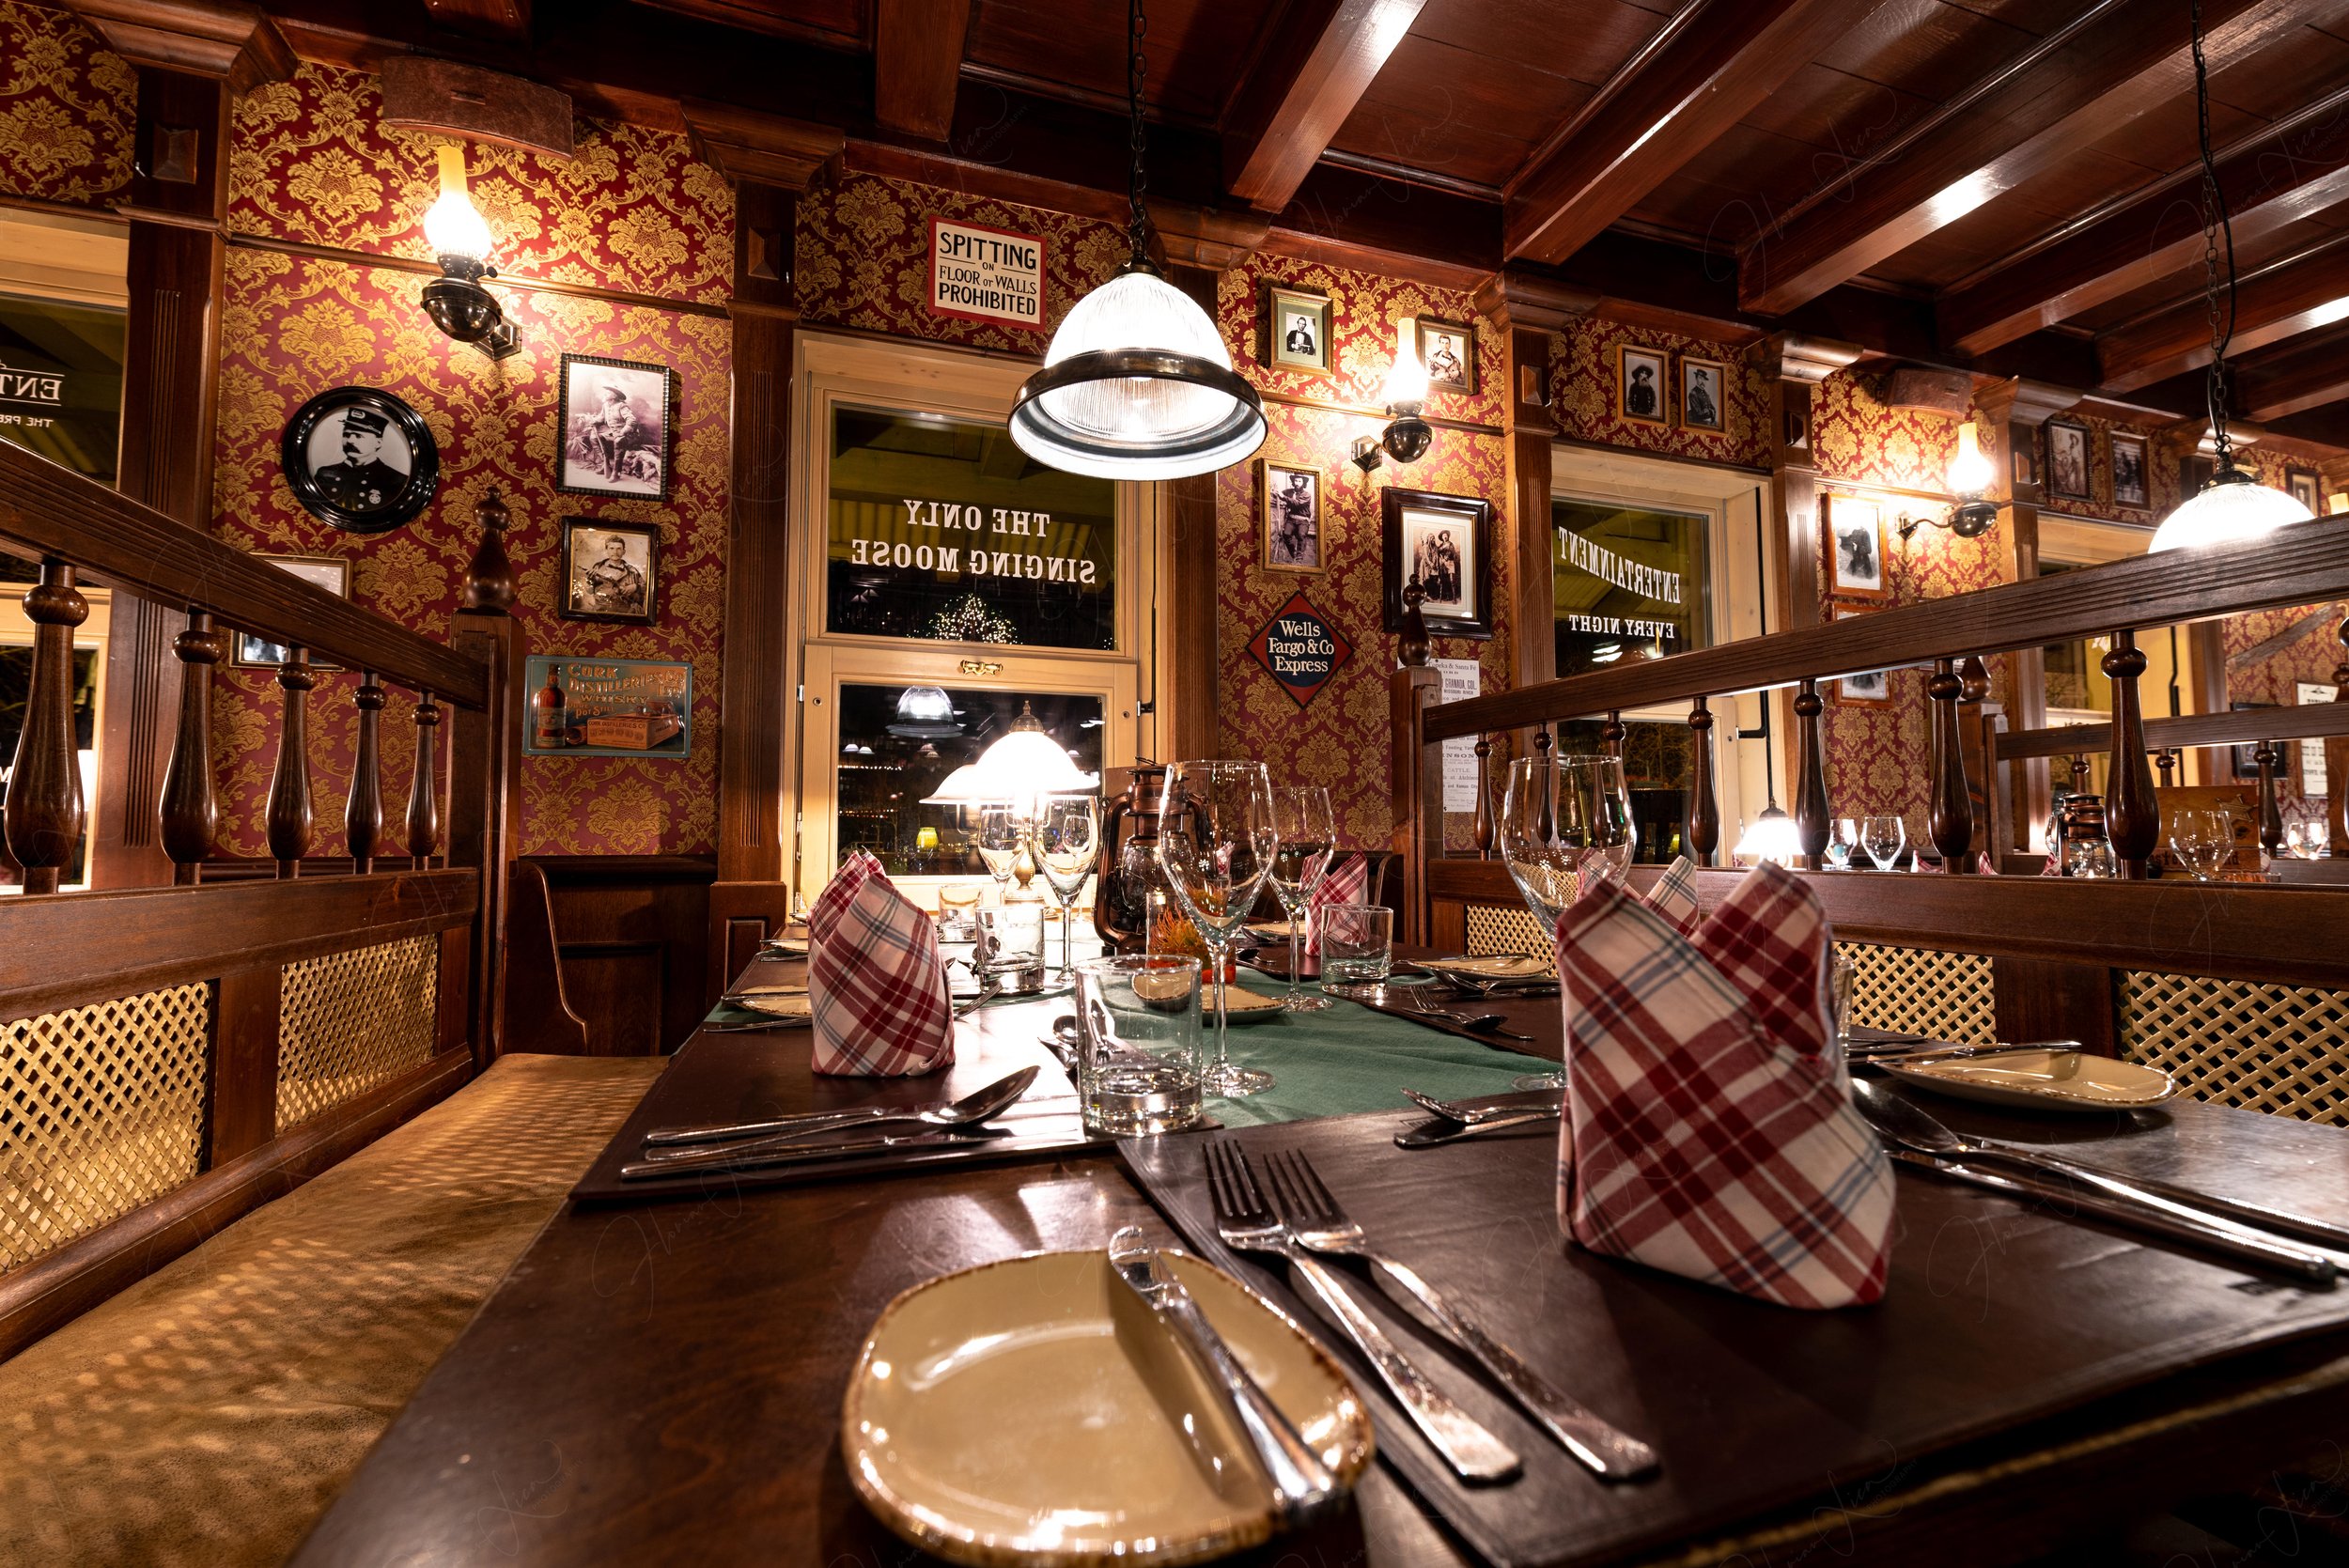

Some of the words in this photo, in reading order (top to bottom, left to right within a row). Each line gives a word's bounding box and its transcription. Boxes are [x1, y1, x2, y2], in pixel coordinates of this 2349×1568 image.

[940, 231, 1036, 270] SPITTING
[982, 261, 994, 271] ON
[940, 265, 980, 285] FLOOR
[995, 275, 1037, 295] WALLS
[939, 283, 1035, 316] PROHIBITED
[1279, 619, 1321, 638] Wells
[1268, 637, 1305, 658] Fargo
[1307, 638, 1318, 655] &
[1319, 639, 1335, 655] Co
[1275, 655, 1329, 676] Express
[580, 693, 650, 705] WHISKY
